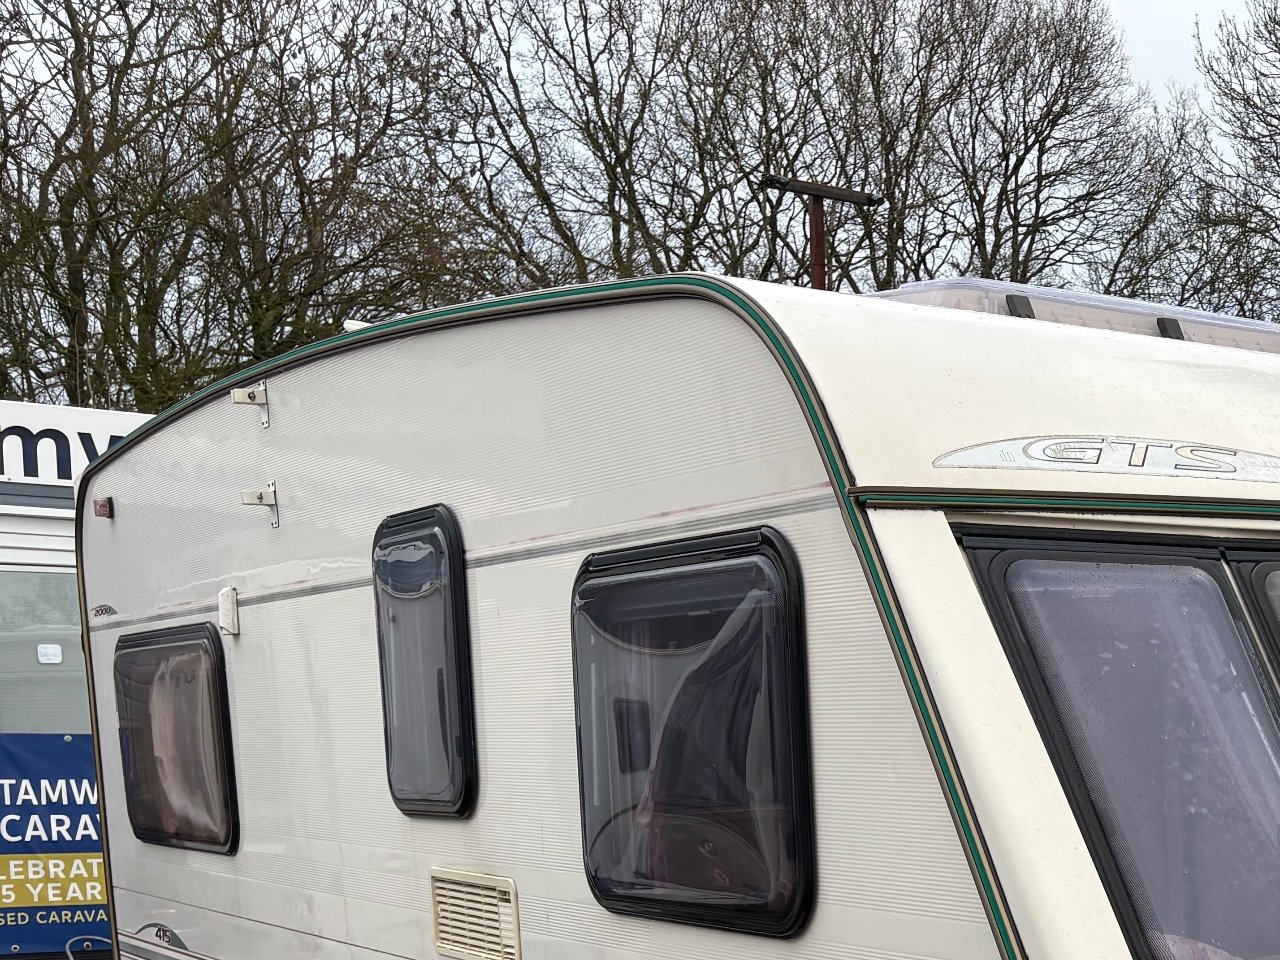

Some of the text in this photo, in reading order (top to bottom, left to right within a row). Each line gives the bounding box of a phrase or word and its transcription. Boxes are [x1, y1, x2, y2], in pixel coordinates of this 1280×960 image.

[1023, 437, 1237, 473] GTS
[94, 606, 111, 617] 2000
[0, 813, 101, 842] CARA
[25, 881, 103, 903] YEAR
[36, 909, 108, 924] CARAVA
[155, 927, 171, 943] 415
